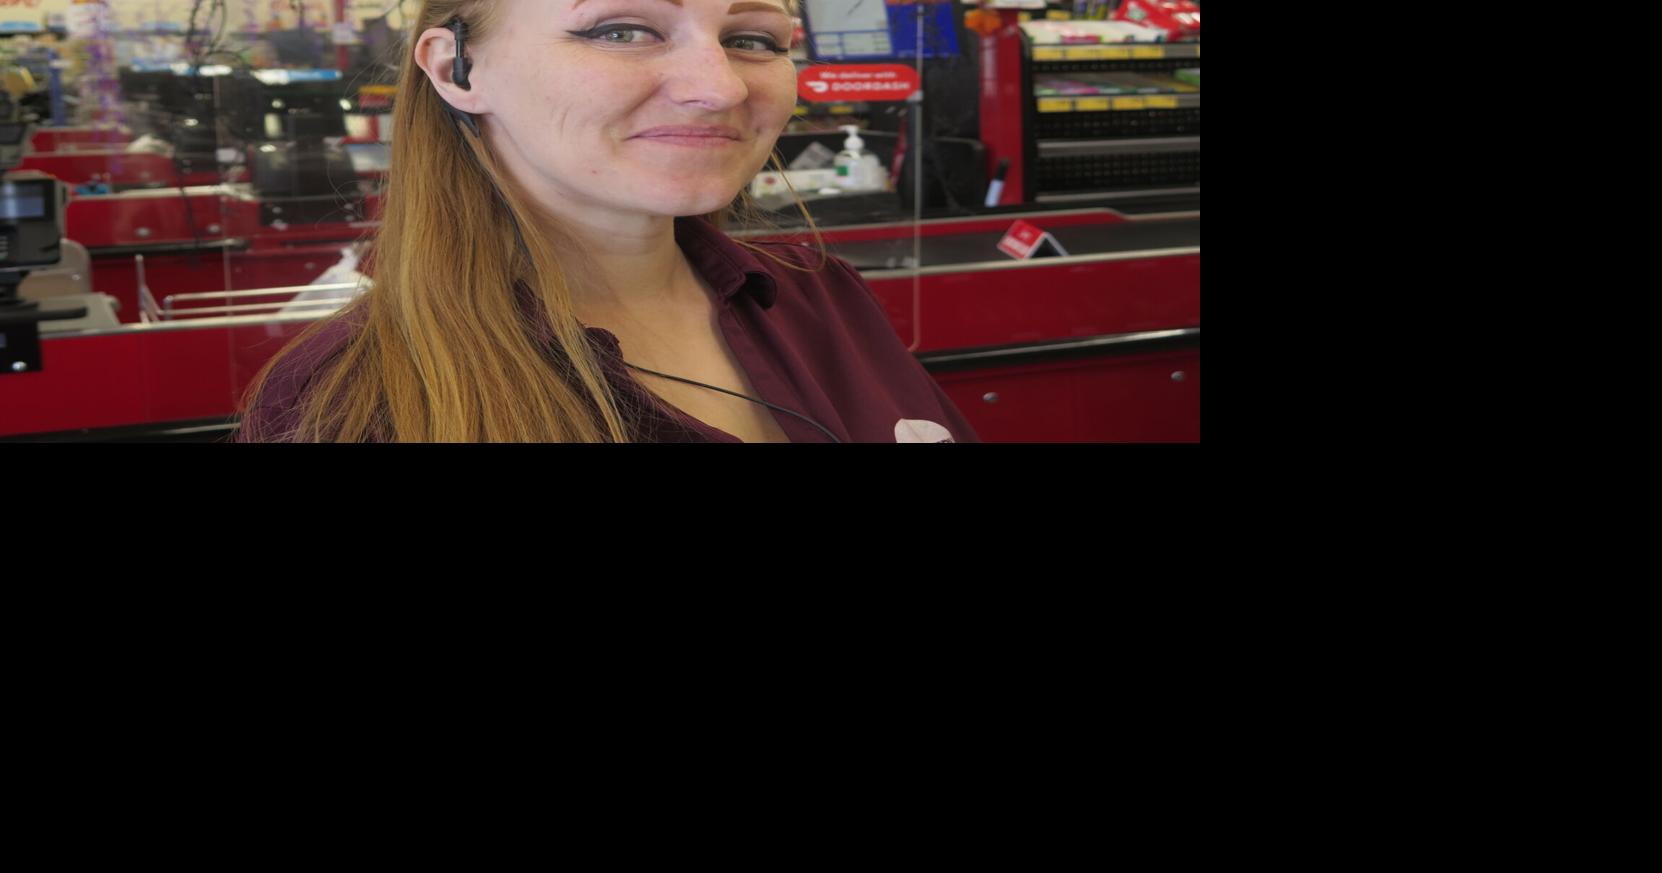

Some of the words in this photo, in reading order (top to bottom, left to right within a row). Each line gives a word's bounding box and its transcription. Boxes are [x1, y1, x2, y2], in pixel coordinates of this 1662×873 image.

[820, 71, 836, 79] We
[838, 71, 871, 79] deliver
[874, 71, 896, 79] with
[831, 81, 910, 91] DOORDASH
